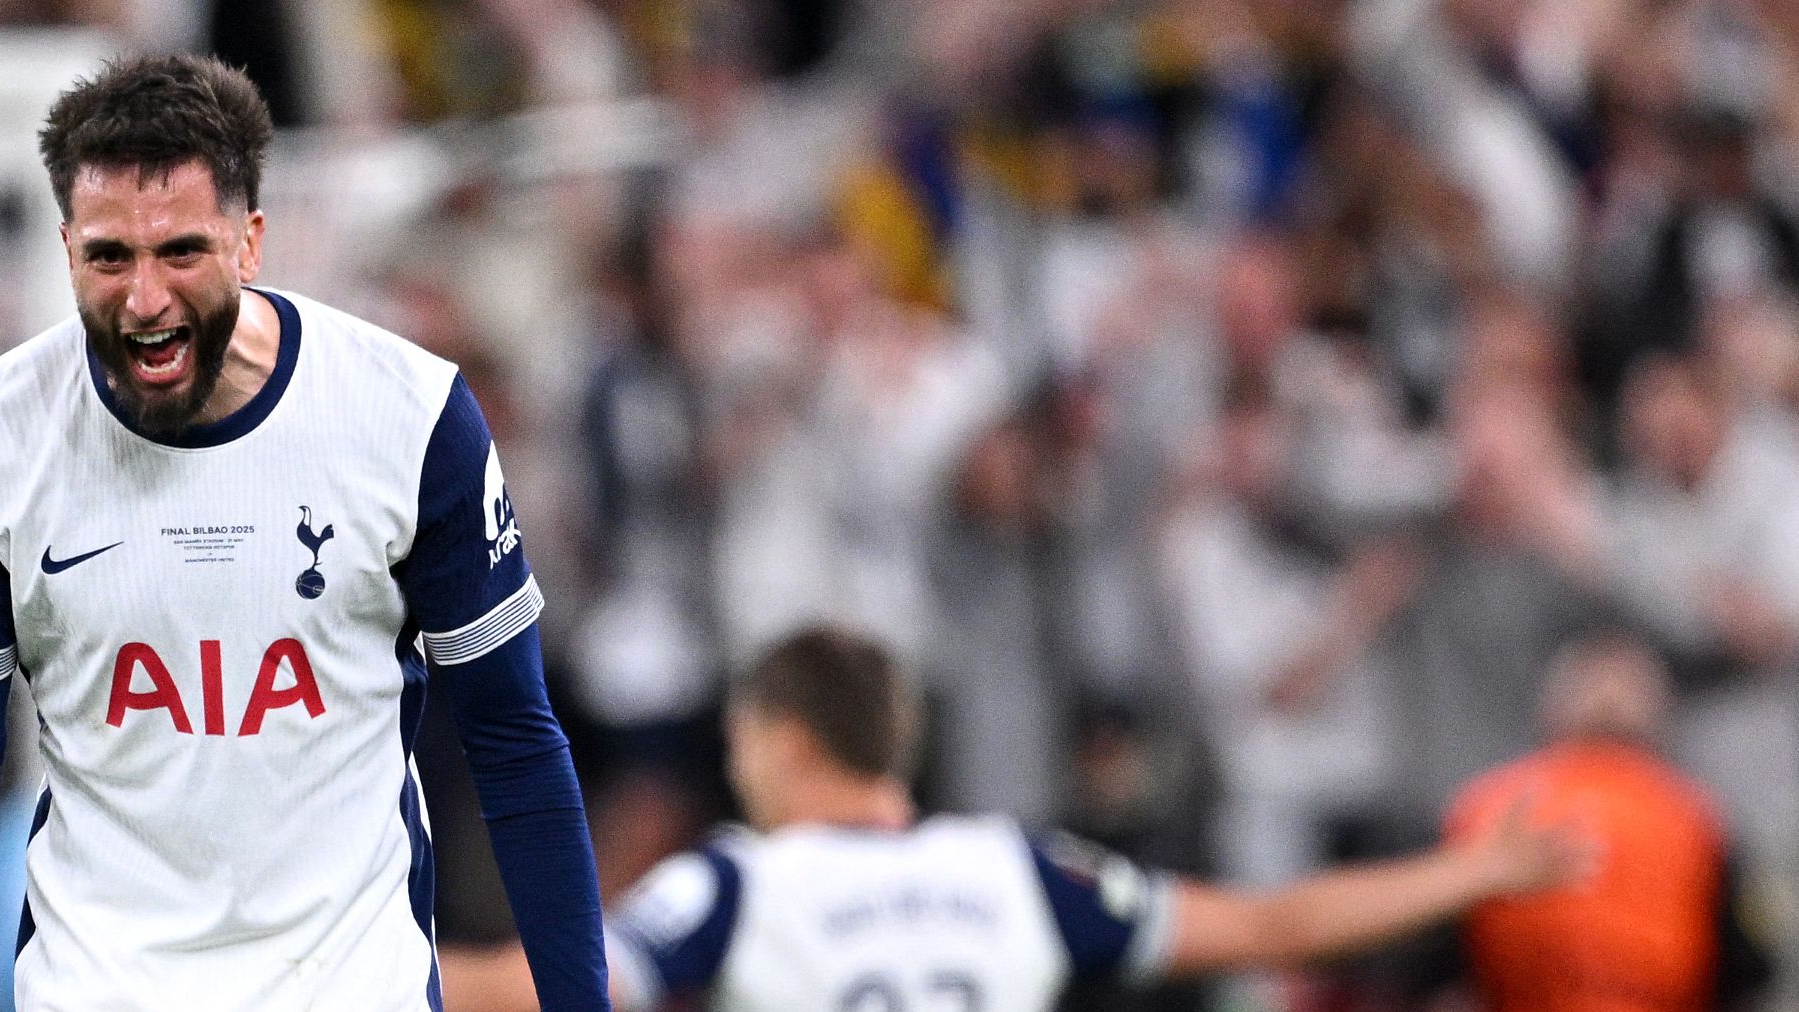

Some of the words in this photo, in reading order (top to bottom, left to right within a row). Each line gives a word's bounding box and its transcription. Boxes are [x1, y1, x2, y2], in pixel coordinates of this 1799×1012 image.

[161, 527, 191, 536] FINAL
[193, 526, 228, 535] BILBAO
[231, 525, 255, 534] 2025
[106, 637, 325, 737] AIA
